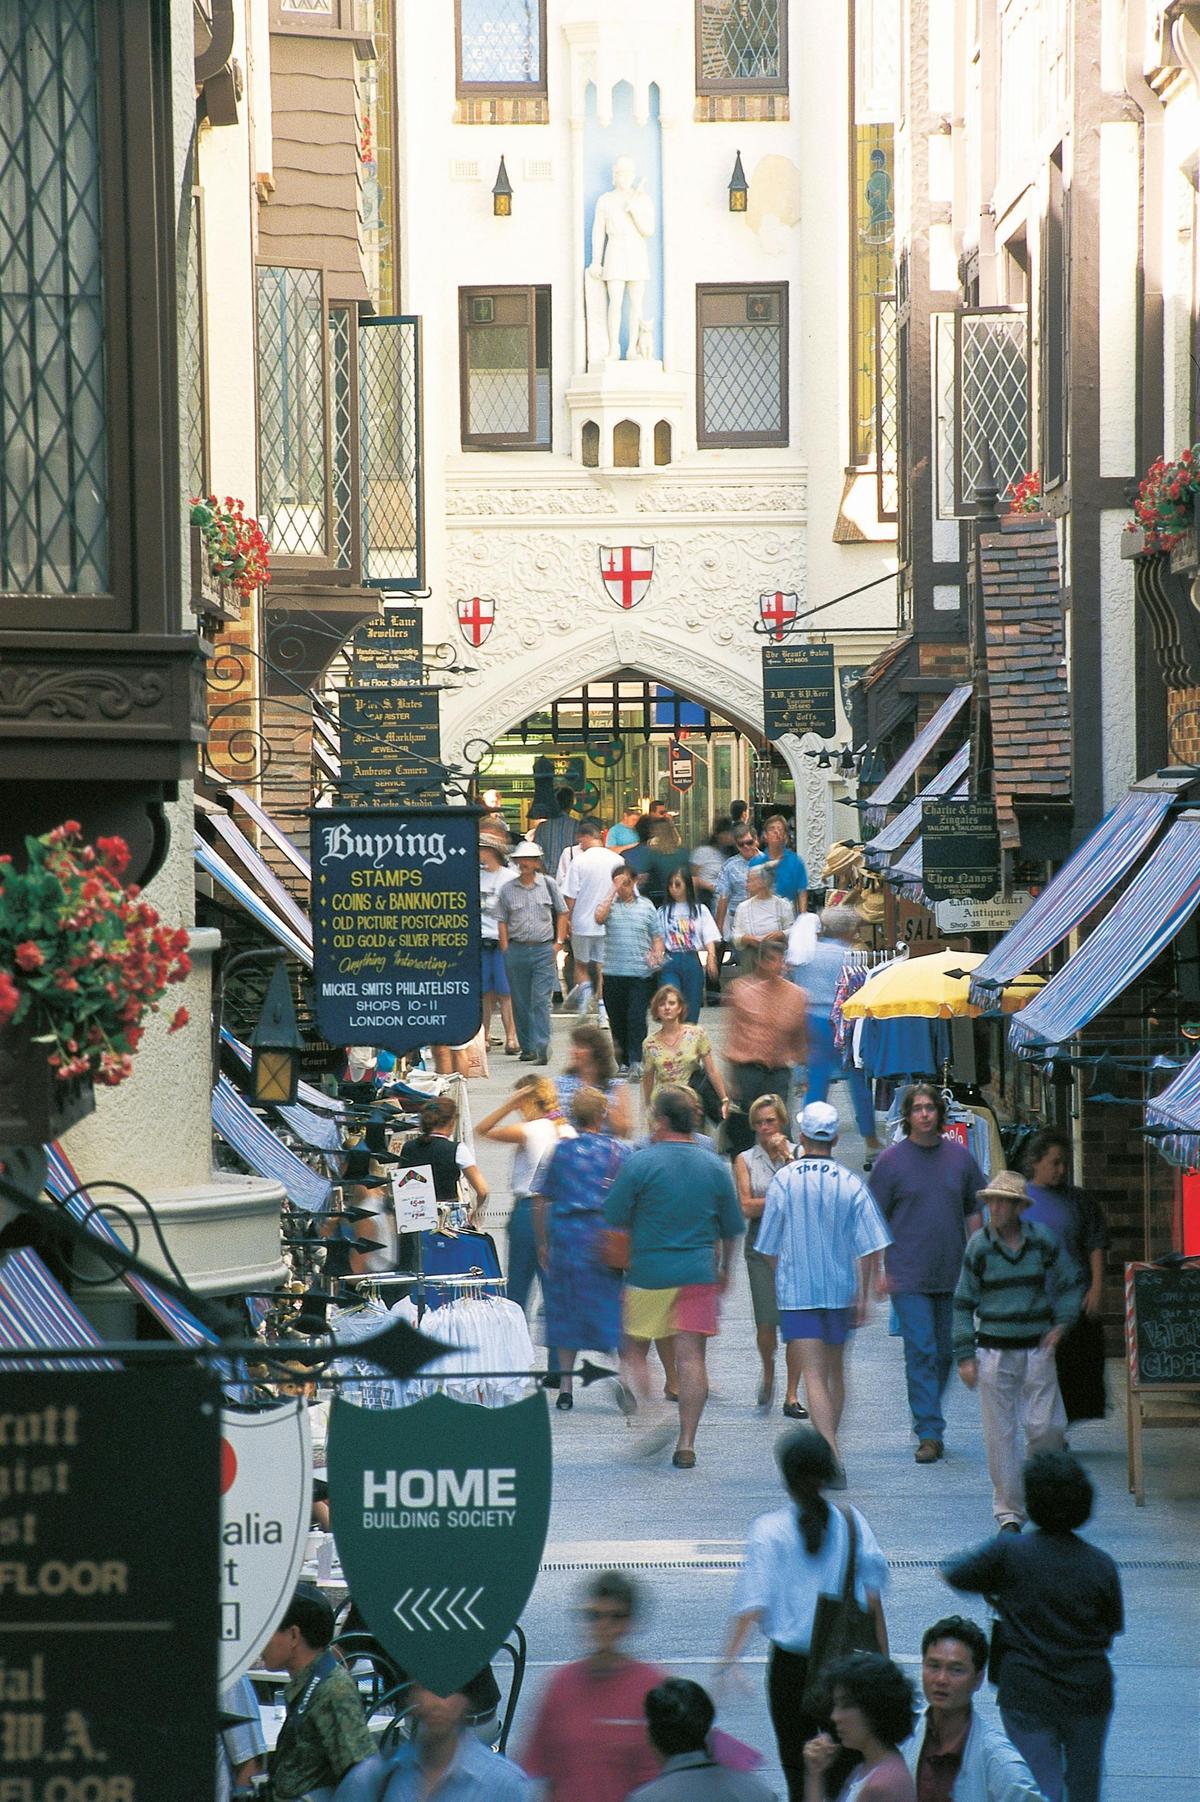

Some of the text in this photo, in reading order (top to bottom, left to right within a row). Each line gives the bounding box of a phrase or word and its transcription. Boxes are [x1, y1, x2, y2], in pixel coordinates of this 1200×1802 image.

[391, 615, 416, 626] Lane
[367, 628, 409, 638] Jewellers
[351, 870, 423, 887] STAMPS
[927, 873, 954, 884] Theo
[332, 892, 467, 911] COINS & BANKNOTES
[963, 908, 1012, 918] Antiques
[332, 914, 469, 930] OLD PICTURE POSTCARDS
[333, 933, 469, 948] OLD GOLD & SILVER PIECES
[322, 981, 470, 996] MICKEL SMITS PHILATELISTS
[356, 1000, 437, 1011] SHOPS 10-11
[350, 1015, 447, 1027] LONDON COURT
[363, 1468, 517, 1509] HOME
[363, 1510, 516, 1529] BUILDING SOCIETY
